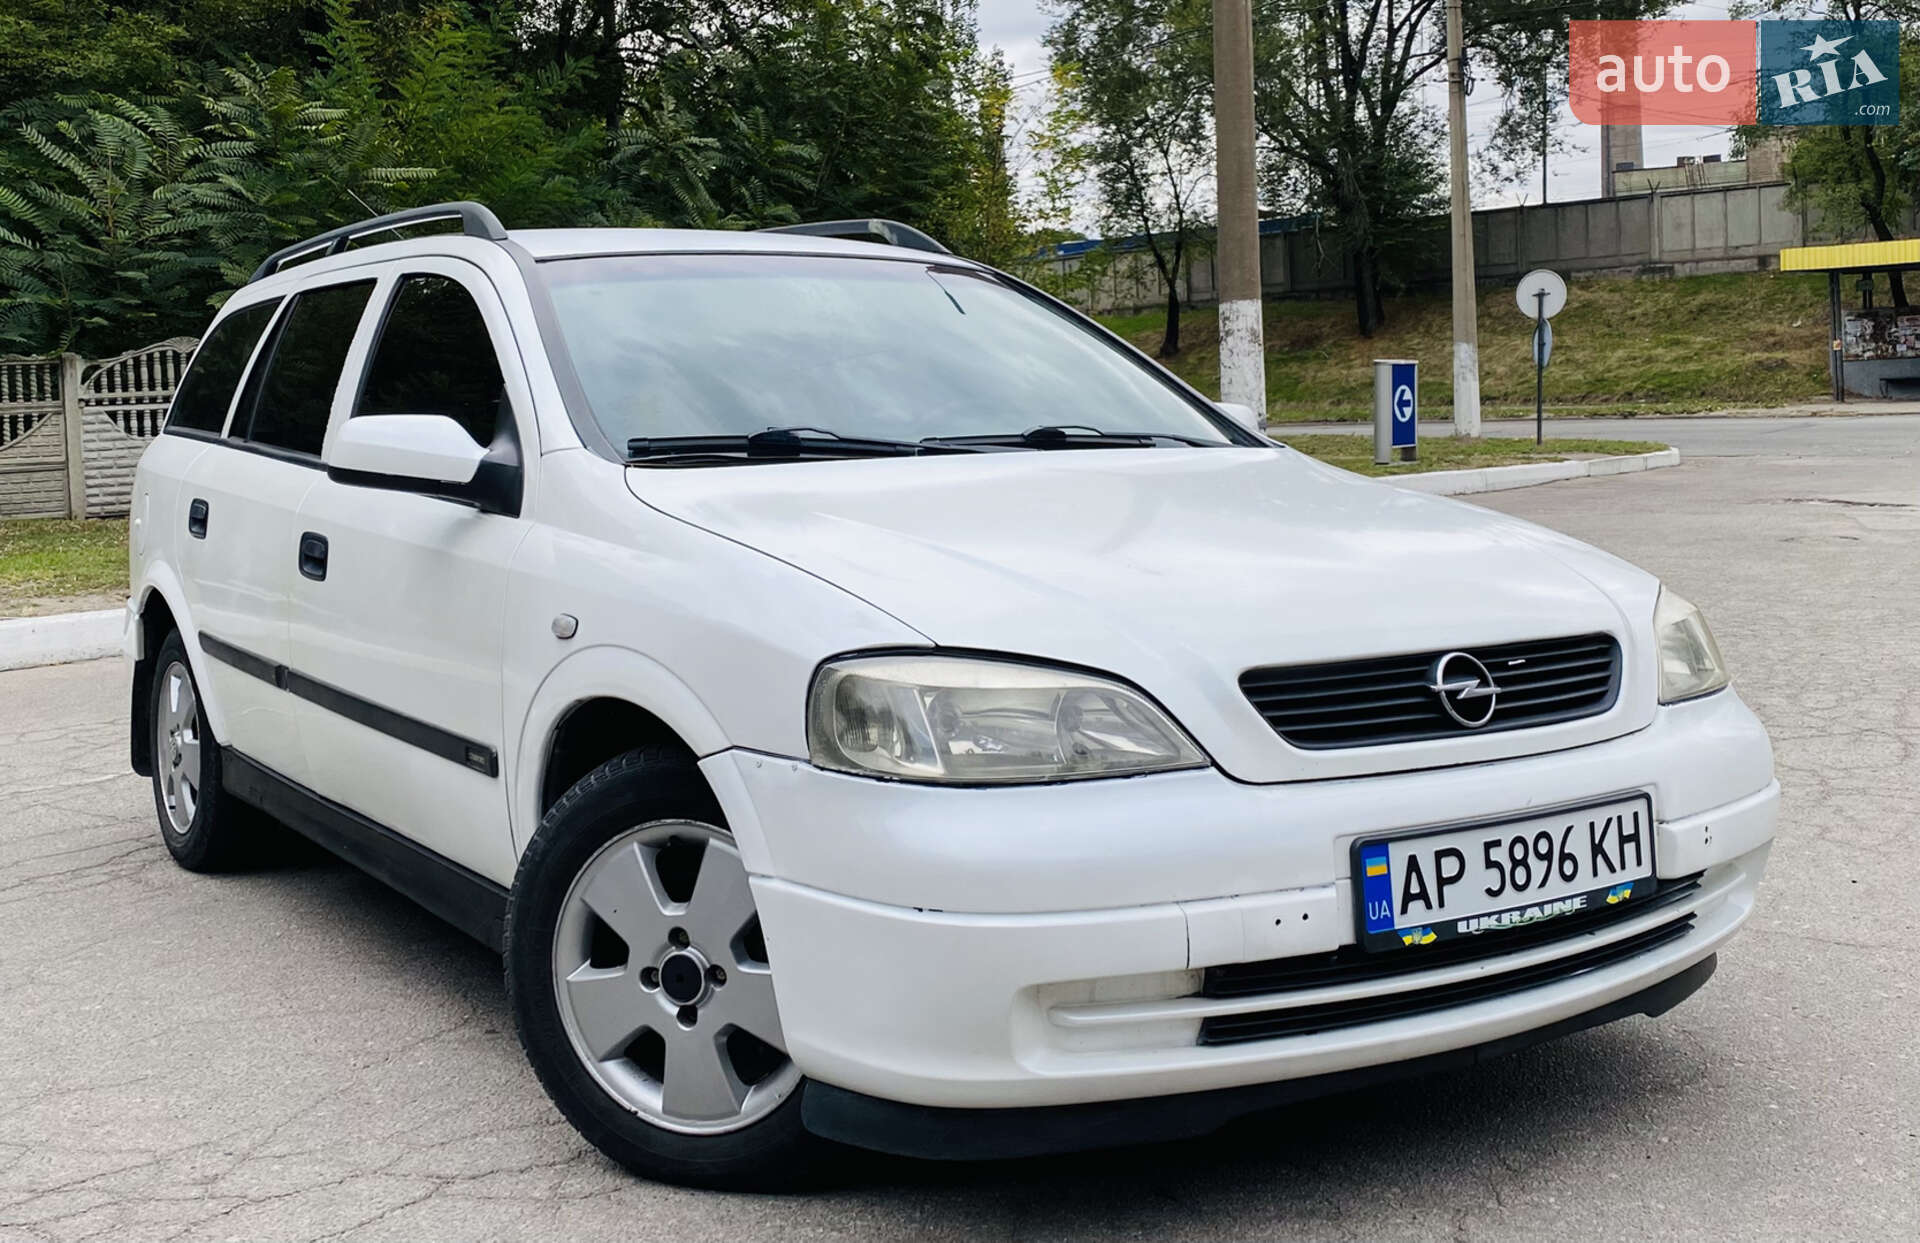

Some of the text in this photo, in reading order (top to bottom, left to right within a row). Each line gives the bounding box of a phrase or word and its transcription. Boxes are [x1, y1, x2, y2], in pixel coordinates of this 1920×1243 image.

[1400, 811, 1643, 915] AP 5896 KH
[1369, 900, 1391, 921] UA
[1457, 895, 1587, 934] UKRAINE
